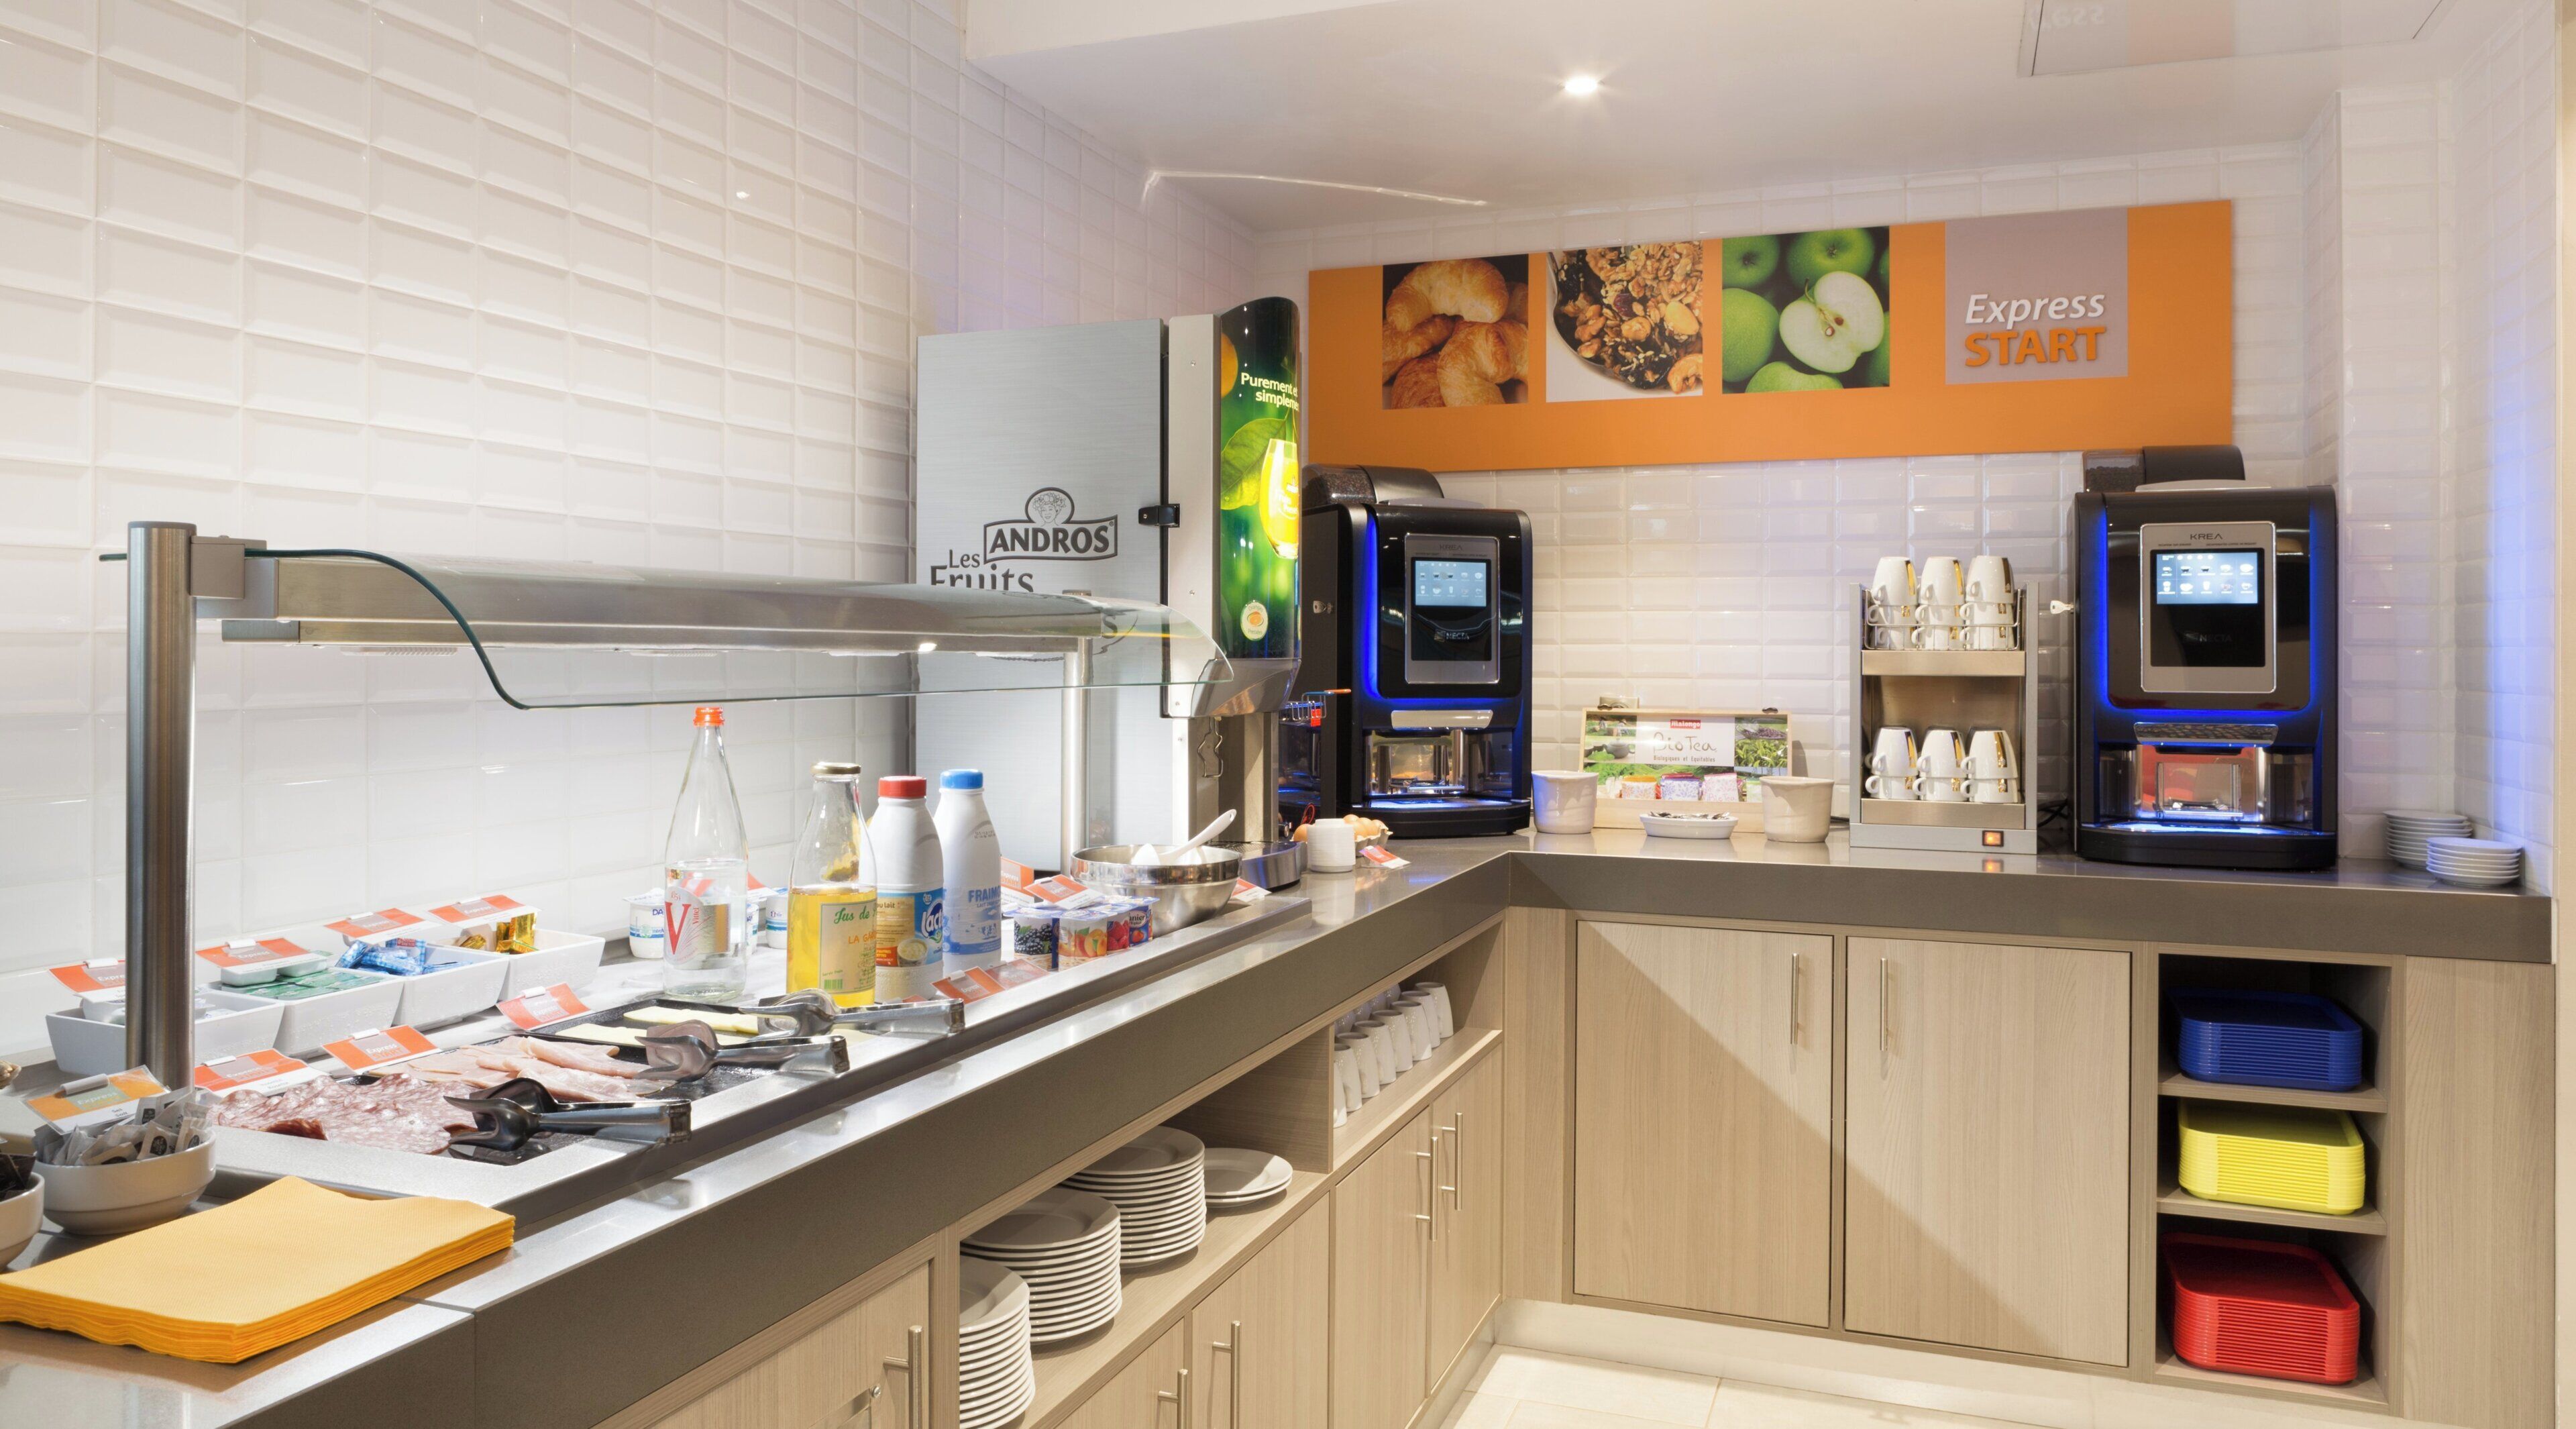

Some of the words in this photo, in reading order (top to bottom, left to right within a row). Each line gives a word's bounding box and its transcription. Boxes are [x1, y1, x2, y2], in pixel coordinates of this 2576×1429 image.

[1966, 294, 2105, 329] Express
[1964, 326, 2106, 366] START
[1241, 372, 1293, 394] Purement
[989, 525, 1110, 553] ANDROS
[949, 549, 980, 568] Les
[834, 907, 855, 924] Jus
[859, 906, 869, 920] de
[848, 936, 859, 944] LA
[366, 1043, 397, 1055] Express
